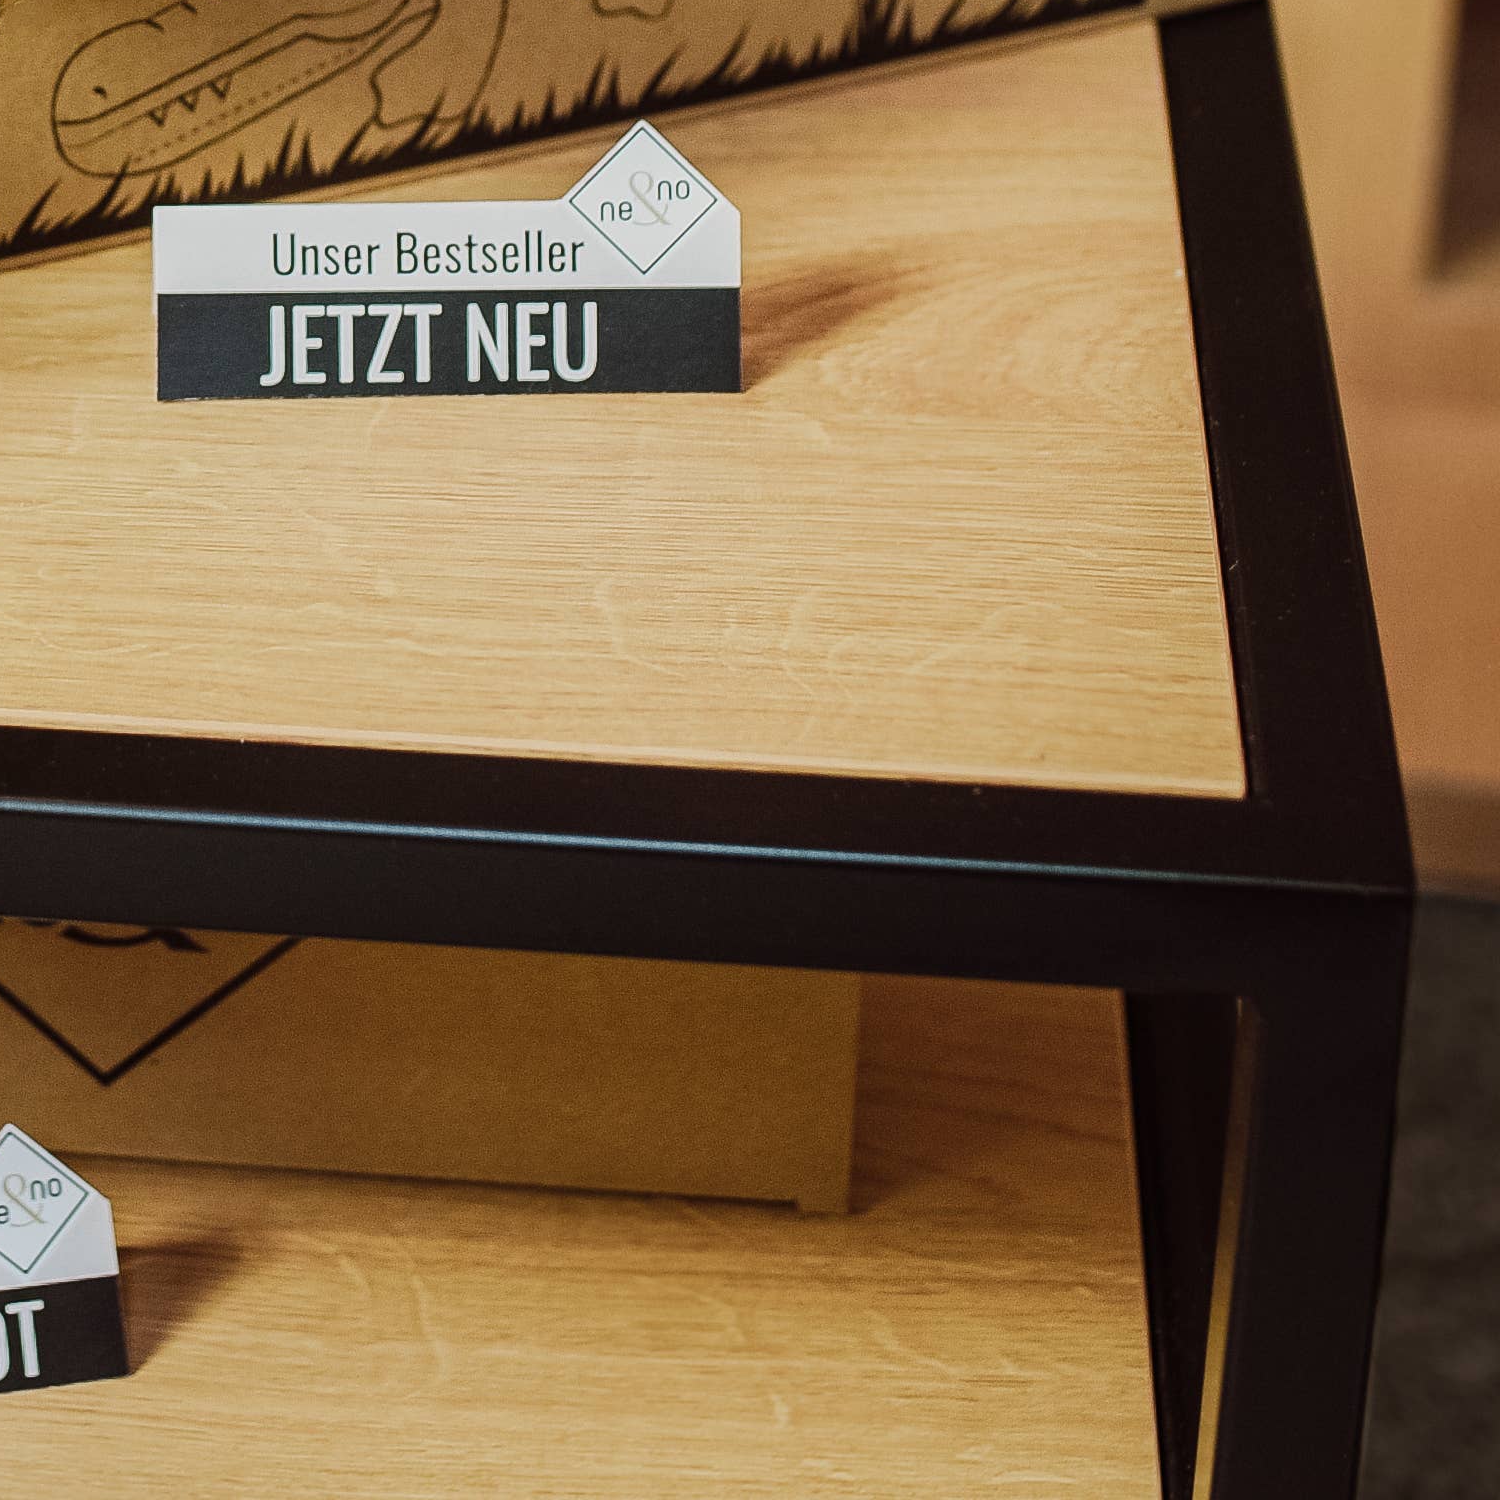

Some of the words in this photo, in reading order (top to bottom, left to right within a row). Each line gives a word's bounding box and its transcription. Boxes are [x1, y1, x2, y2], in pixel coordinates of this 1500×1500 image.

[600, 170, 691, 226] ne&no
[271, 231, 381, 277] Unser
[395, 229, 586, 276] Bestseller
[259, 302, 443, 388] JETZT
[466, 300, 599, 383] NEU
